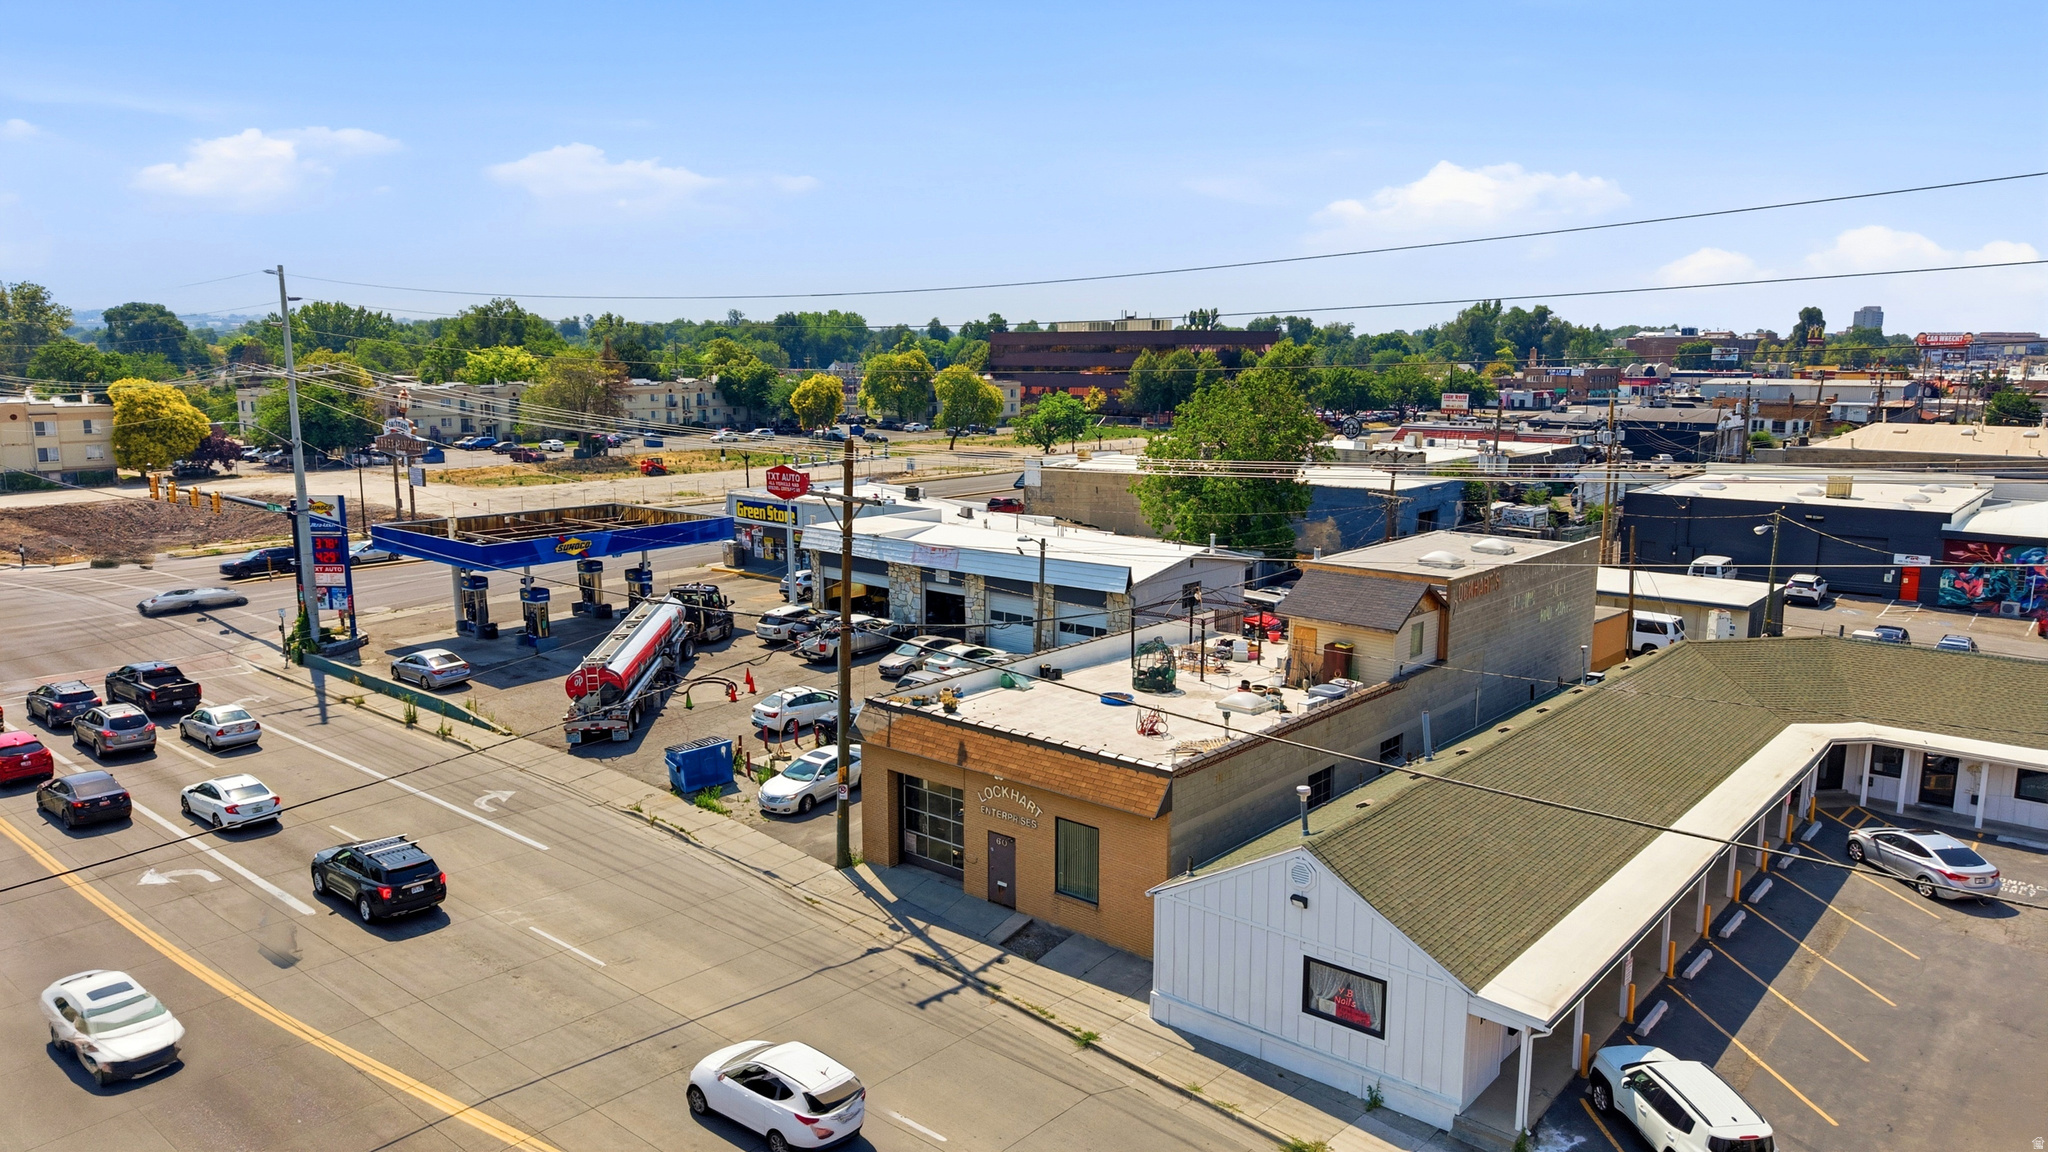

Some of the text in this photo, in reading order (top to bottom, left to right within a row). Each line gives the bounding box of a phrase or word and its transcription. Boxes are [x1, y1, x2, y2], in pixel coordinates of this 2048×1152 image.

[767, 472, 800, 482] TXT AUTO
[736, 502, 796, 524] Green Store
[557, 541, 591, 552] SUNOCO
[977, 785, 1043, 818] LOCKHART
[980, 805, 1038, 829] ENTERPRISES
[996, 838, 1008, 846] 60
[1334, 996, 1356, 1008] Nails
